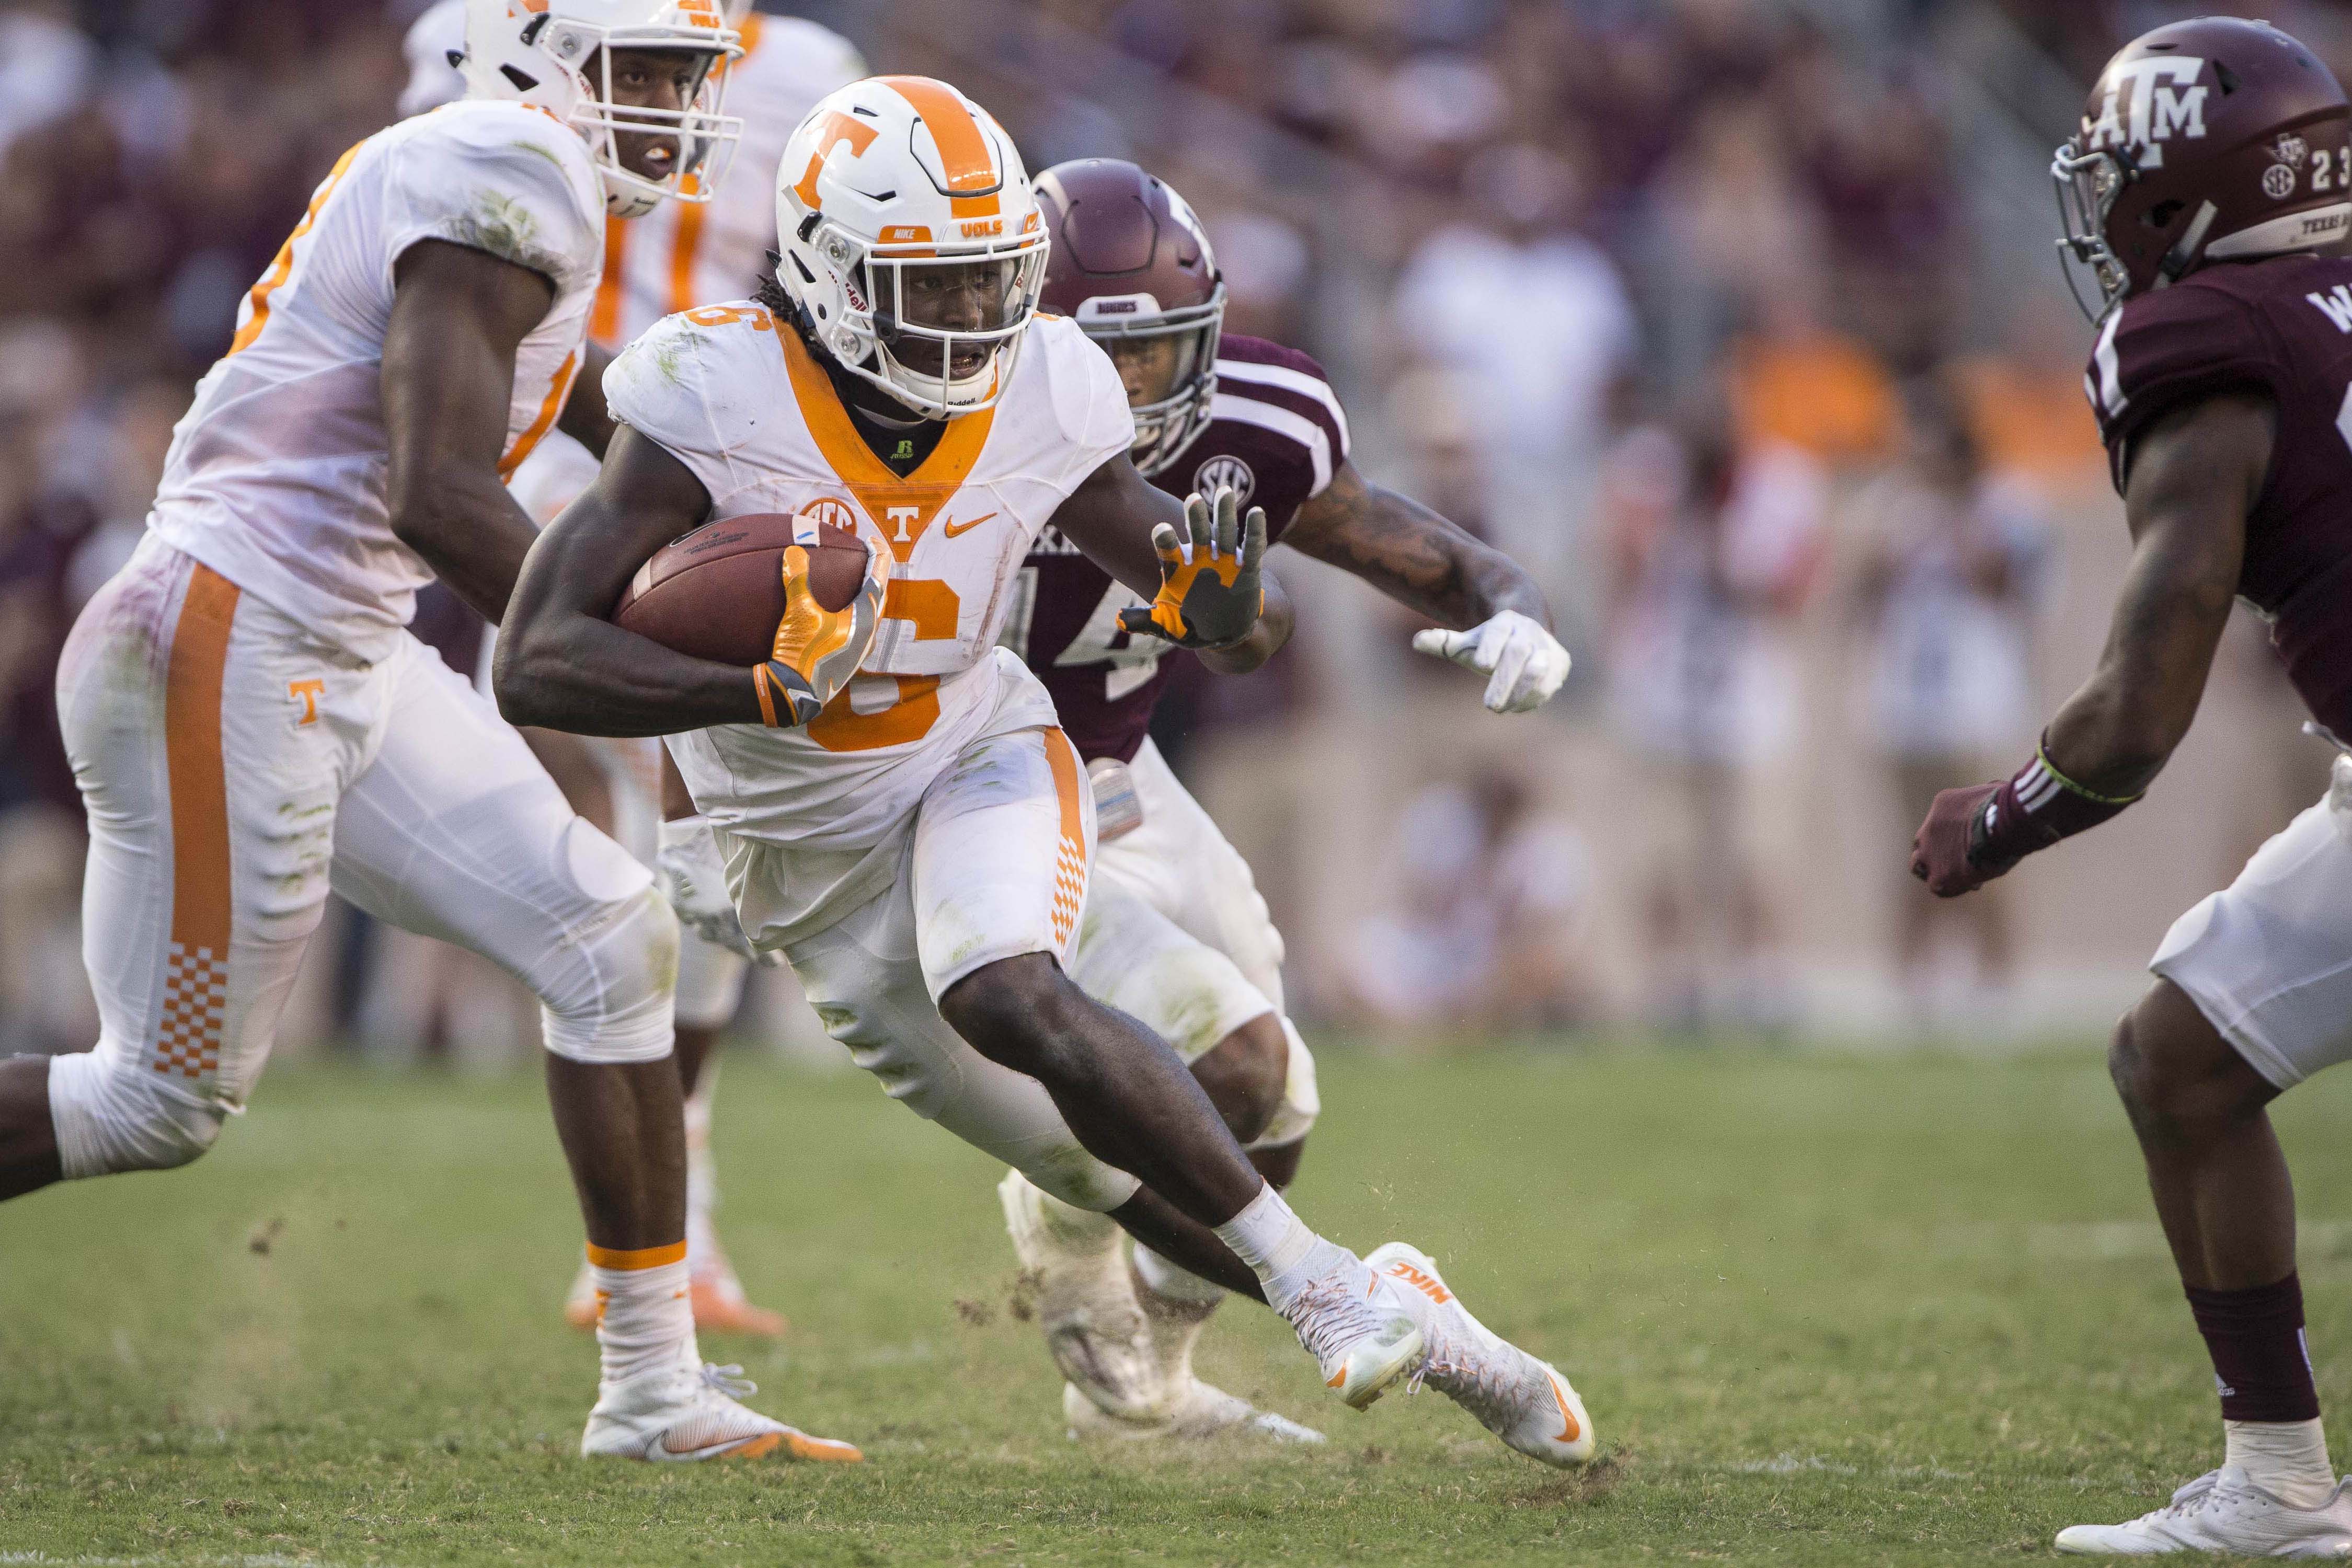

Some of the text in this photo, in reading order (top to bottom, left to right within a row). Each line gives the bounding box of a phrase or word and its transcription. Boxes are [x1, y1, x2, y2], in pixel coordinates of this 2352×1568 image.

[793, 109, 880, 212] T
[893, 228, 916, 239] NIKE
[961, 220, 1003, 237] VOLS
[887, 506, 920, 542] T
[807, 578, 960, 752] 6
[289, 678, 326, 727] T
[1383, 1261, 1454, 1305] NIKE
